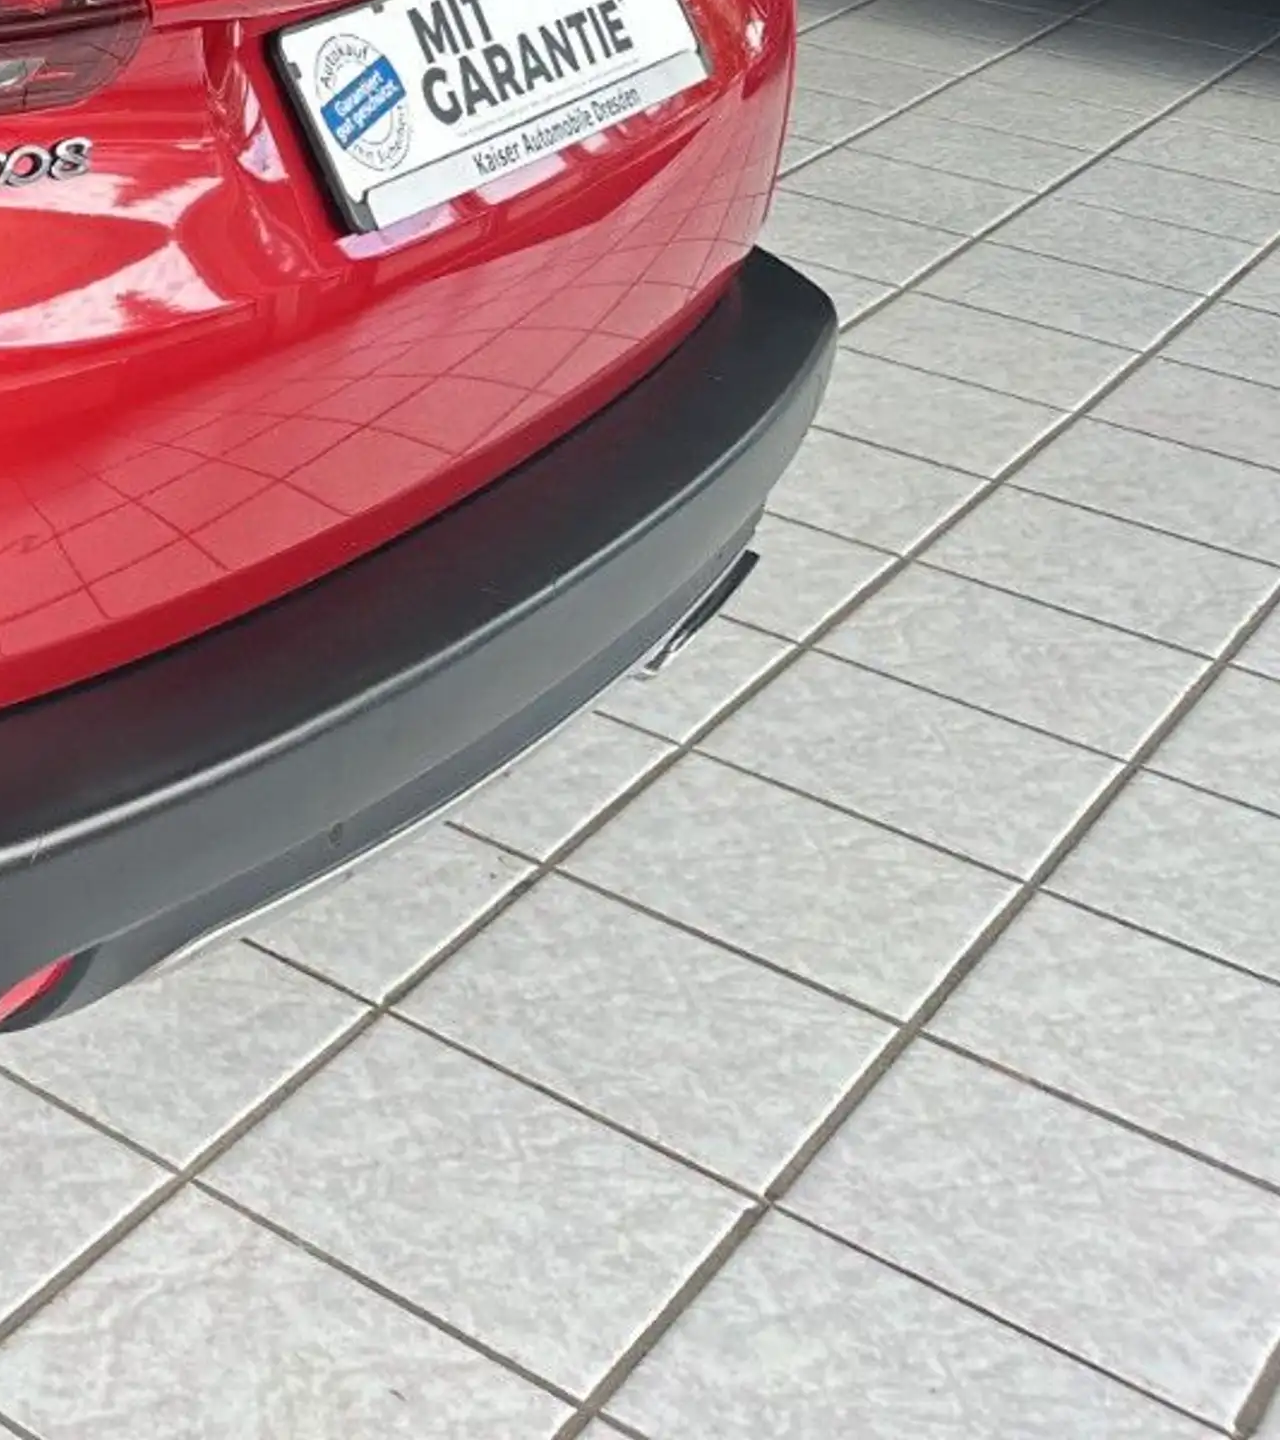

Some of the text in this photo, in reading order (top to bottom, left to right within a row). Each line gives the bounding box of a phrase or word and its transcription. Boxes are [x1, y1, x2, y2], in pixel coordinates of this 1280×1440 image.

[472, 140, 520, 176] Kaiser
[521, 107, 594, 154] Automobile
[591, 88, 642, 123] Dresden
